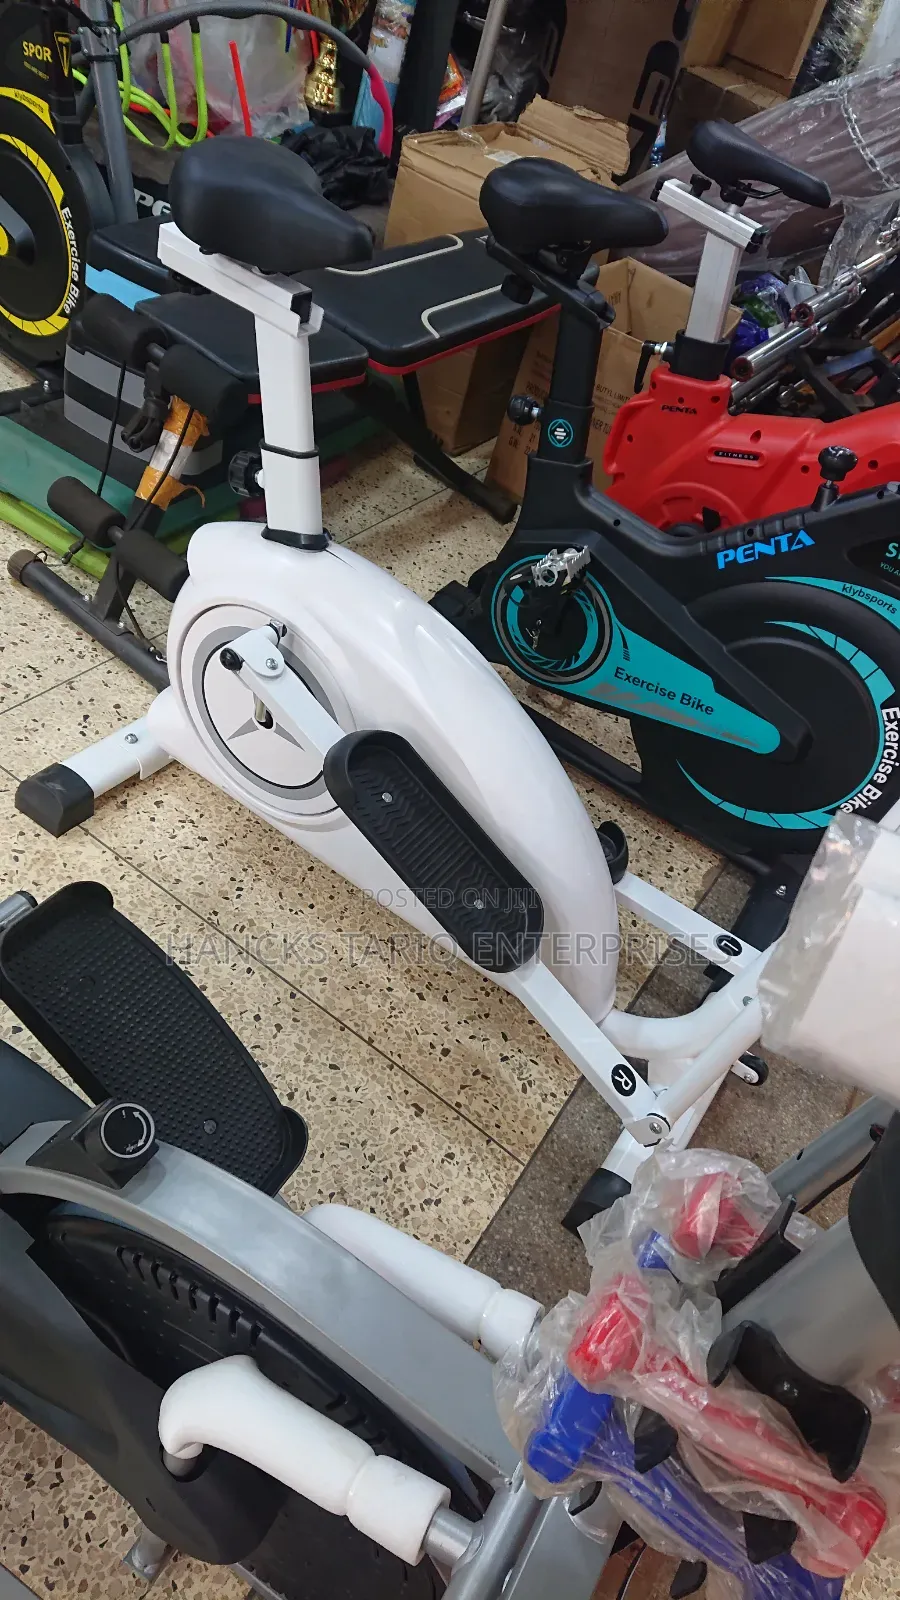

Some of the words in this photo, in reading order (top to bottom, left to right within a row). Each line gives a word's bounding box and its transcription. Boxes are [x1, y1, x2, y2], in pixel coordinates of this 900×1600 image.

[61, 206, 81, 282] Exercise
[63, 283, 80, 315] Bike
[661, 404, 698, 415] PENTA
[718, 450, 755, 460] FITNESS
[716, 530, 815, 570] PENTA
[885, 542, 900, 560] S
[841, 583, 898, 615] klybsports
[614, 666, 677, 701] Exercise
[679, 692, 715, 716] Bike
[873, 707, 900, 784] Exercise
[840, 783, 883, 814] Bike
